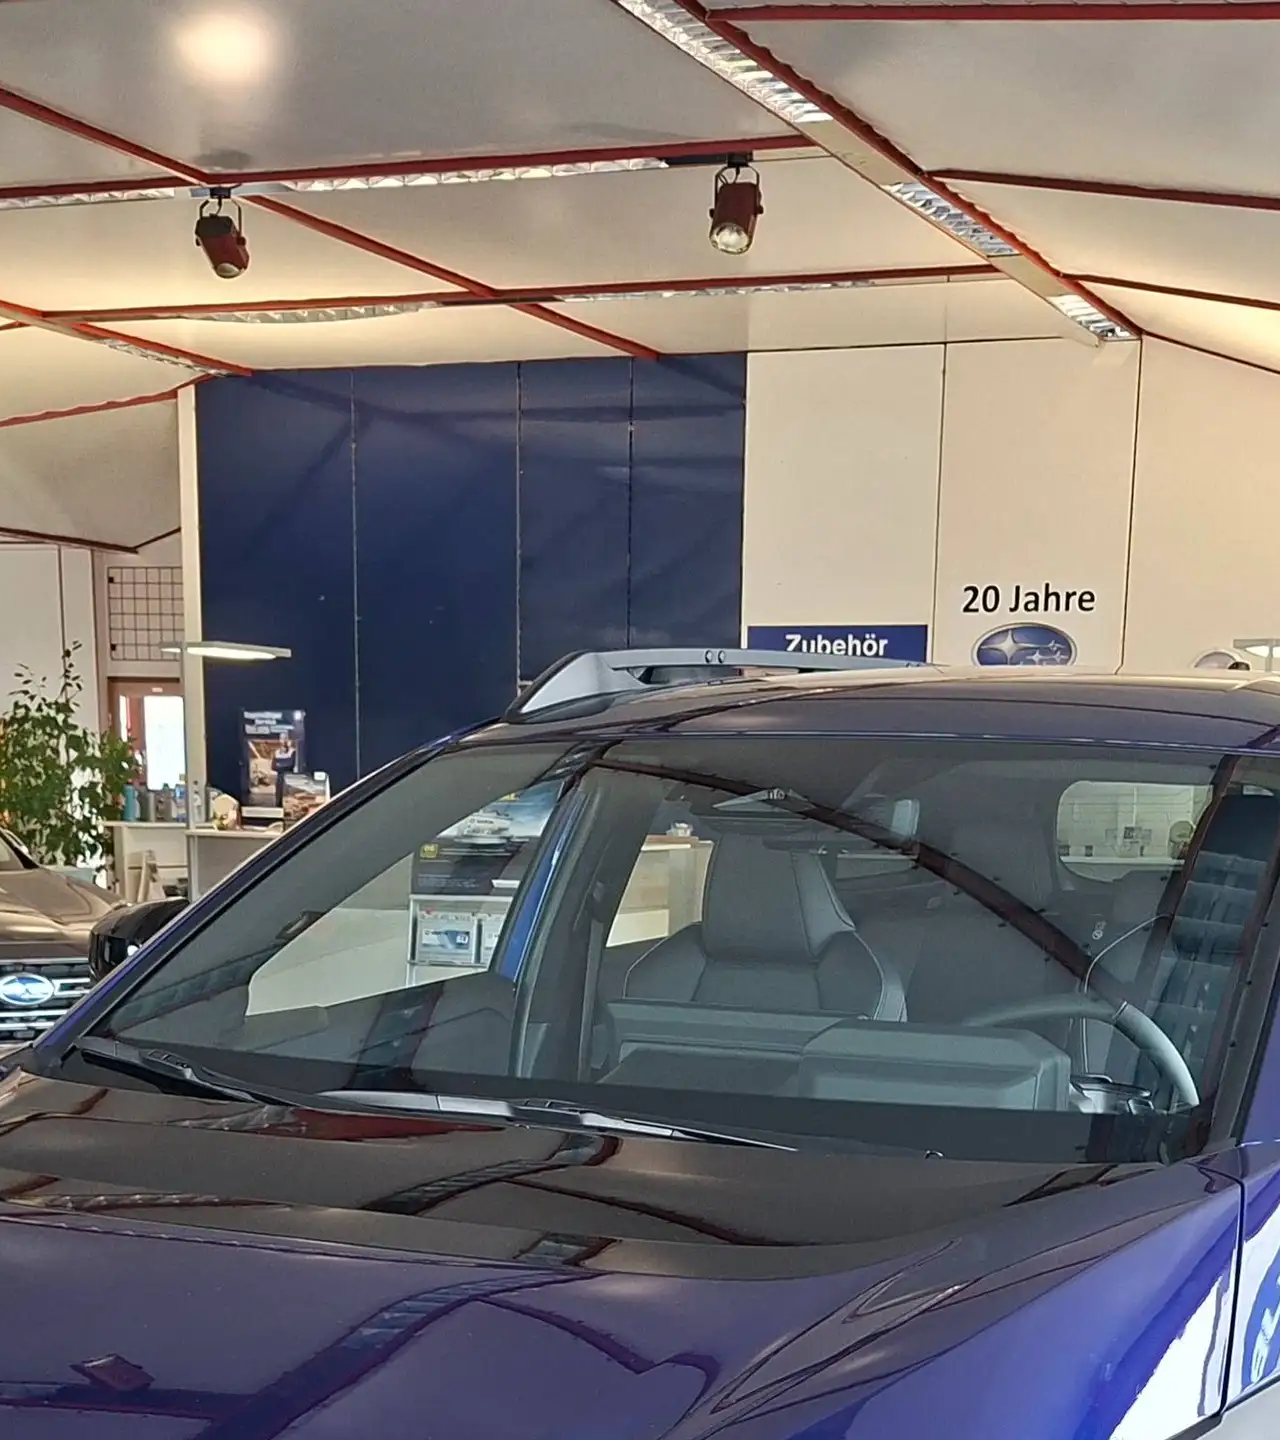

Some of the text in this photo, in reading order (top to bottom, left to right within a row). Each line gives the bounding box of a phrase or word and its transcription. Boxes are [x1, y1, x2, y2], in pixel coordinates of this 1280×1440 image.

[962, 583, 1096, 613] 20 Jahre
[785, 632, 889, 657] Zubehör
